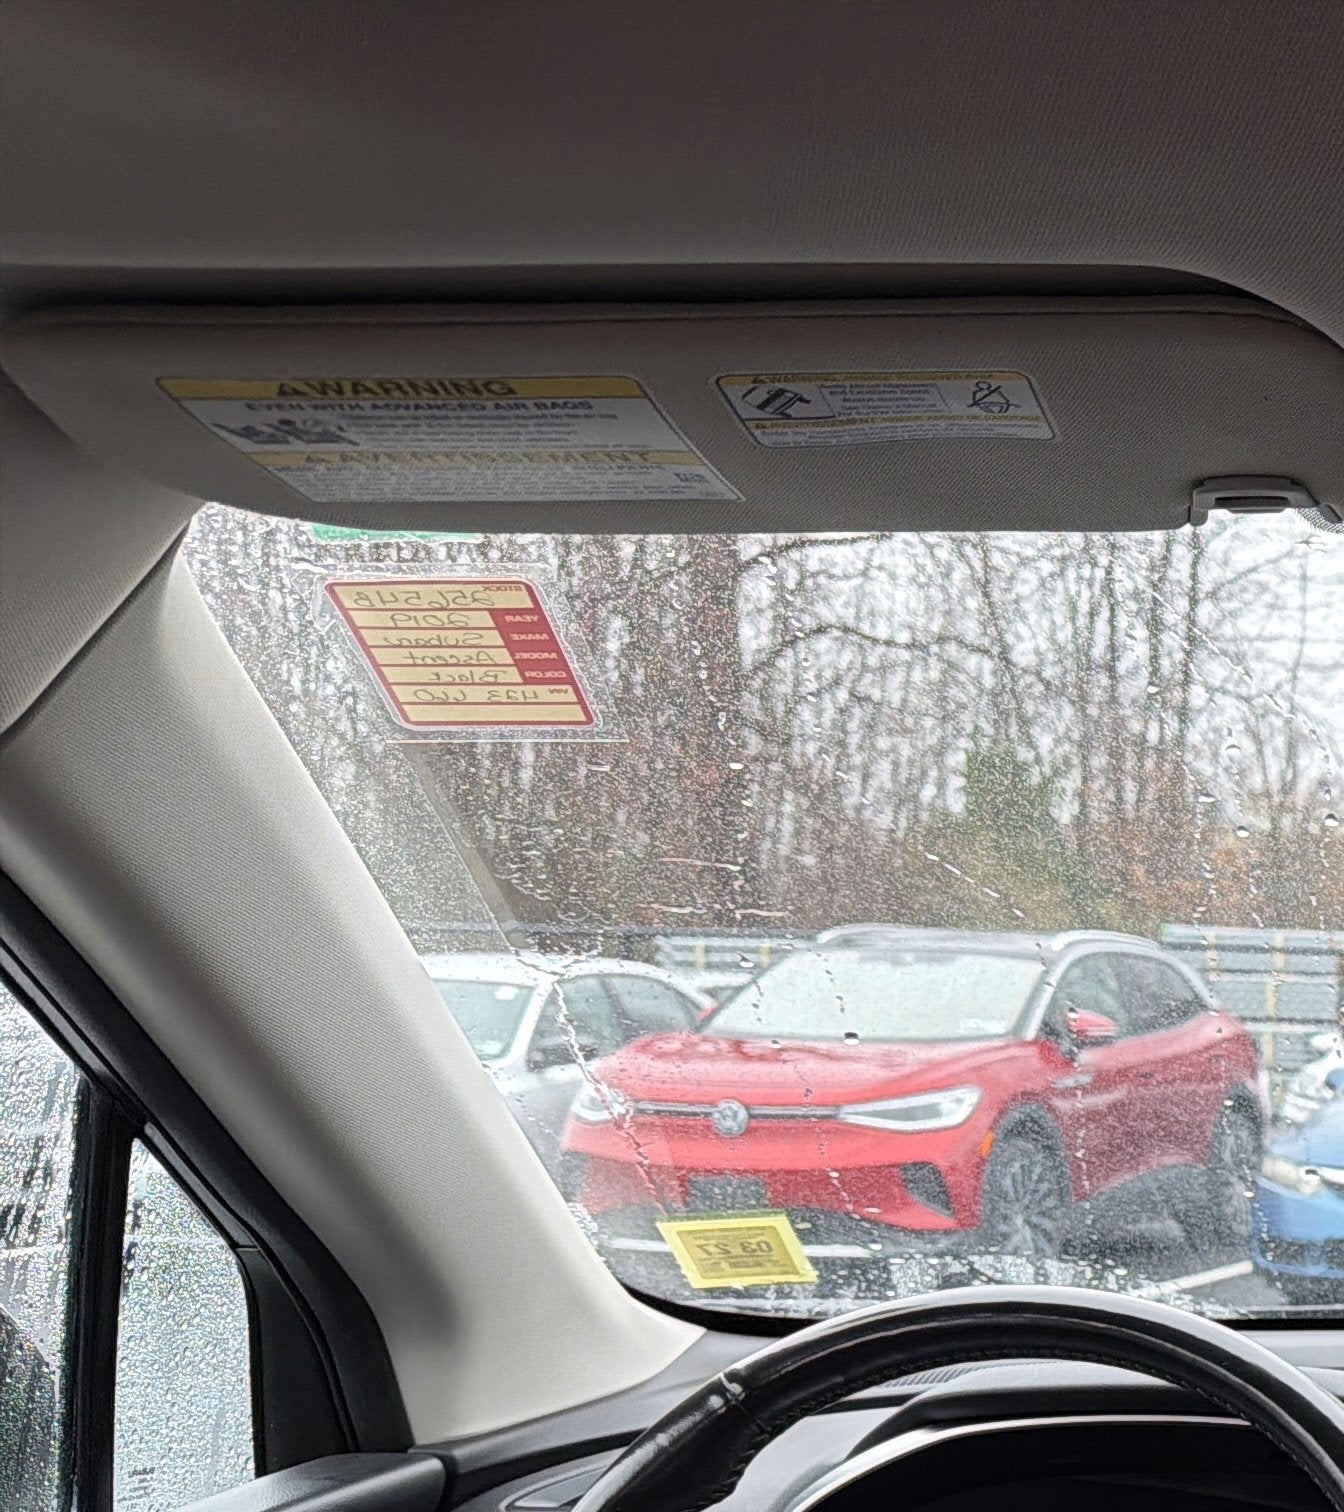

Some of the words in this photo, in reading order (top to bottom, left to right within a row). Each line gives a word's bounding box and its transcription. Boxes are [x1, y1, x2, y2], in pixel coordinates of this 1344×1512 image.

[313, 379, 516, 396] WARNING
[370, 401, 487, 411] ADVANCED
[494, 401, 528, 411] AIR
[535, 400, 593, 411] BAGS
